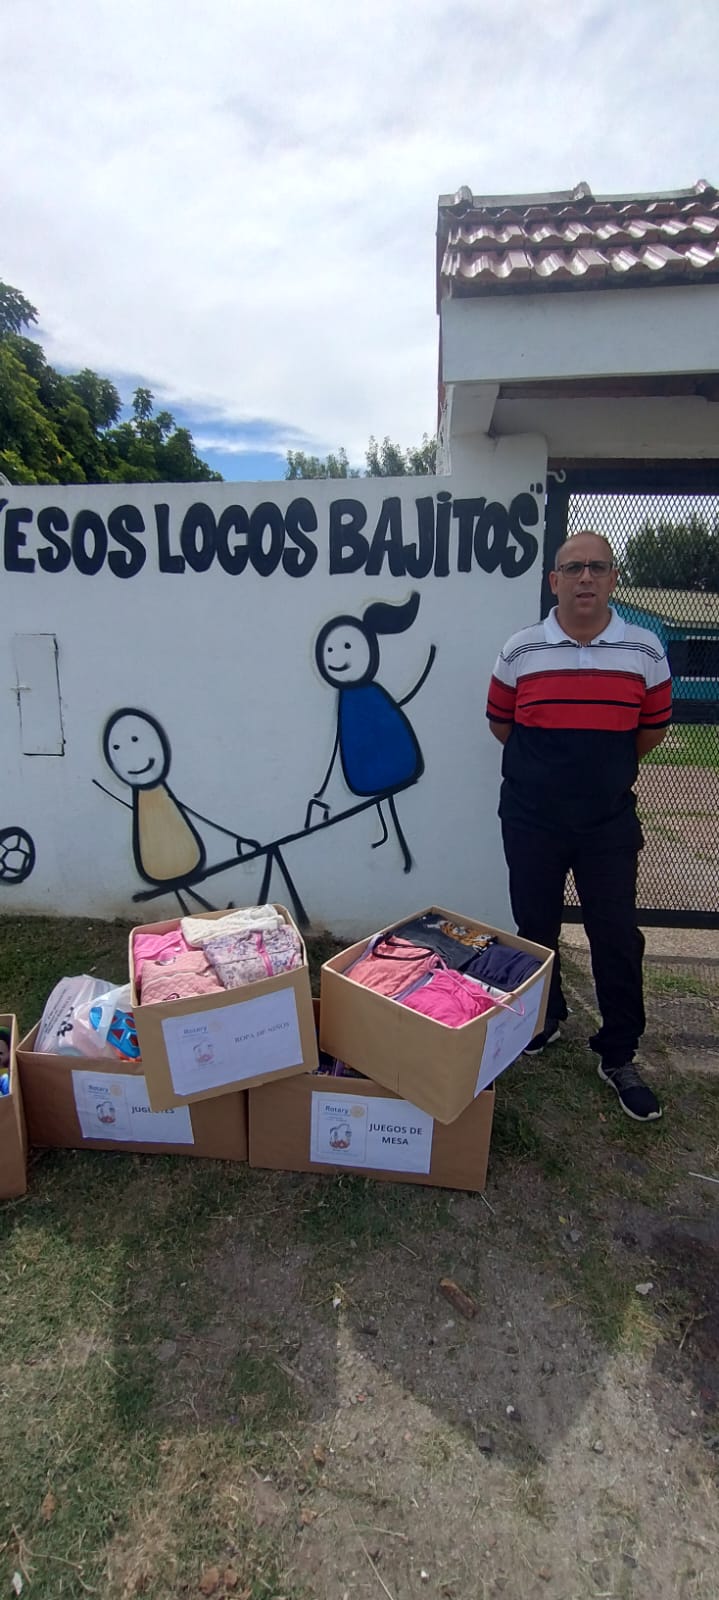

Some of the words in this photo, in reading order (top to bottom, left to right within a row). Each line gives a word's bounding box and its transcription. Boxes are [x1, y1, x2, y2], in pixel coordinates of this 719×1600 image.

[154, 497, 318, 578] LOCOS
[234, 1033, 255, 1043] ROPA
[88, 1084, 109, 1093] Rotary
[131, 1105, 175, 1114] JUGUES
[325, 1105, 349, 1115] Rotary
[369, 1123, 407, 1134] JUEGOS
[409, 1127, 424, 1136] DE
[382, 1136, 409, 1146] MESA
